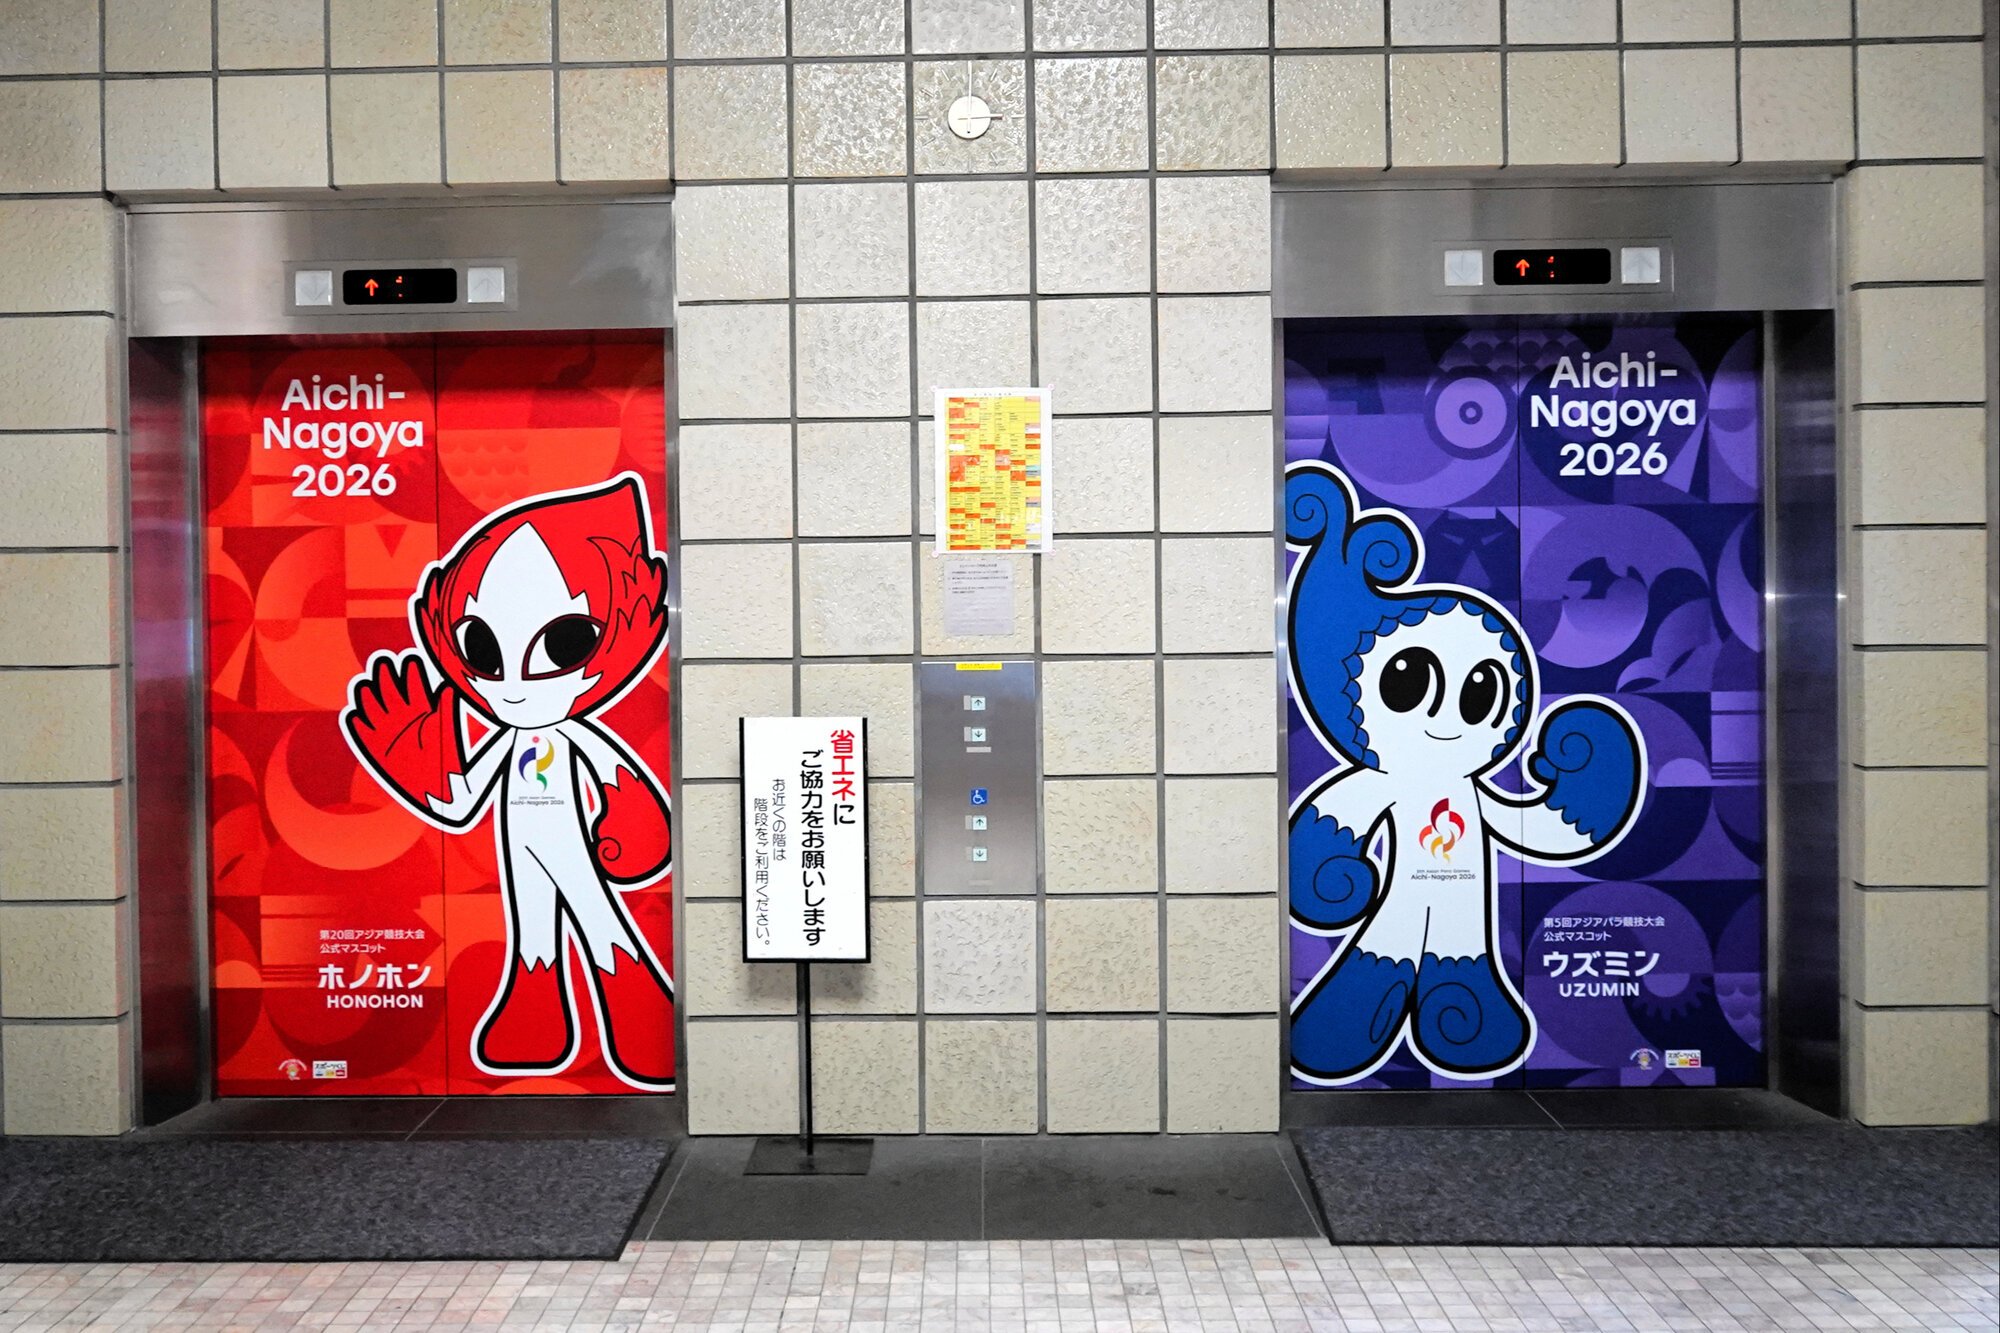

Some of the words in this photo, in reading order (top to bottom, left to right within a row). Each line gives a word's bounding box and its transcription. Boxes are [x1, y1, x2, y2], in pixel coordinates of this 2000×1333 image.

[1549, 351, 1678, 389] Aichi-
[280, 373, 406, 411] Aichi-
[1530, 394, 1697, 437] Nagoya
[263, 416, 424, 459] Nagoya
[1559, 441, 1668, 476] 2026
[291, 463, 397, 497] 2026
[830, 729, 856, 826] 省エネに
[772, 778, 787, 861] お近くの階は
[799, 748, 826, 946] ご協力をお願いします
[754, 797, 771, 946] 階段をご利用ください。
[1410, 873, 1457, 881] Aichi-Nagoya
[320, 943, 386, 954] 公式マスコット
[1543, 931, 1612, 942] 公式マスコット
[318, 963, 431, 990] ホノホン
[1543, 951, 1660, 978] ウズミン
[327, 994, 423, 1009] HONOHON
[1559, 983, 1639, 997] UZUMIN
